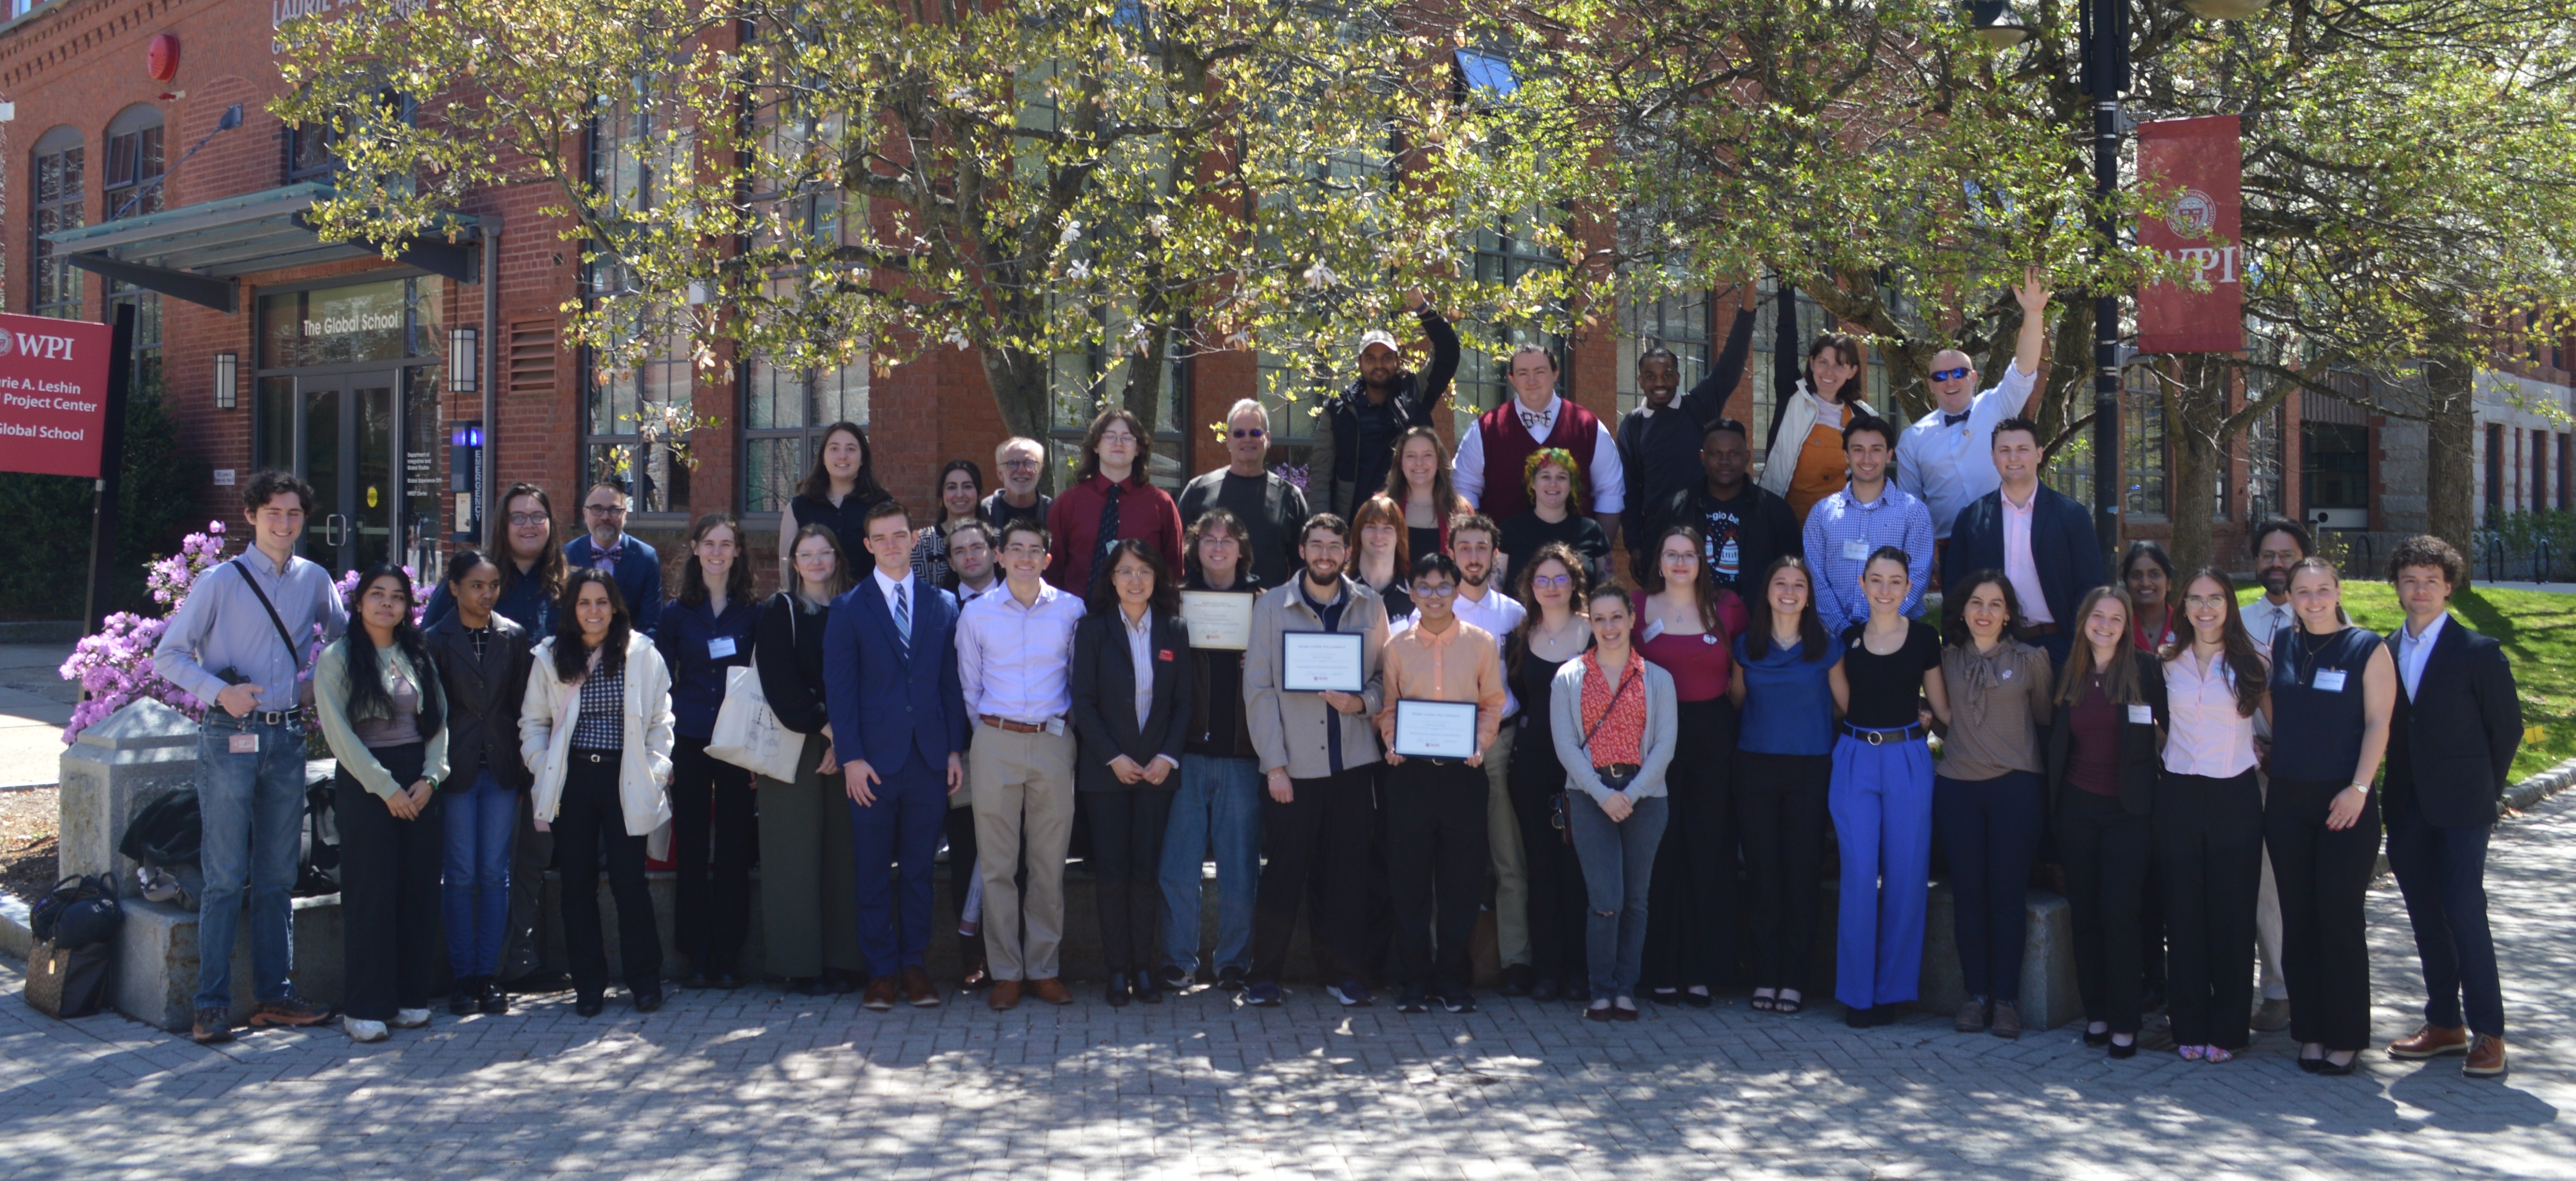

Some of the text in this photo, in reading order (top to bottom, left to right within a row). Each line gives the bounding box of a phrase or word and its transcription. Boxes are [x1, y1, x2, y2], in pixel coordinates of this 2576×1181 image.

[304, 310, 399, 336] The Global School
[16, 333, 75, 360] WPI
[0, 377, 81, 395] rie A. Leshin
[4, 393, 97, 412] Project Center
[39, 426, 84, 441] School
